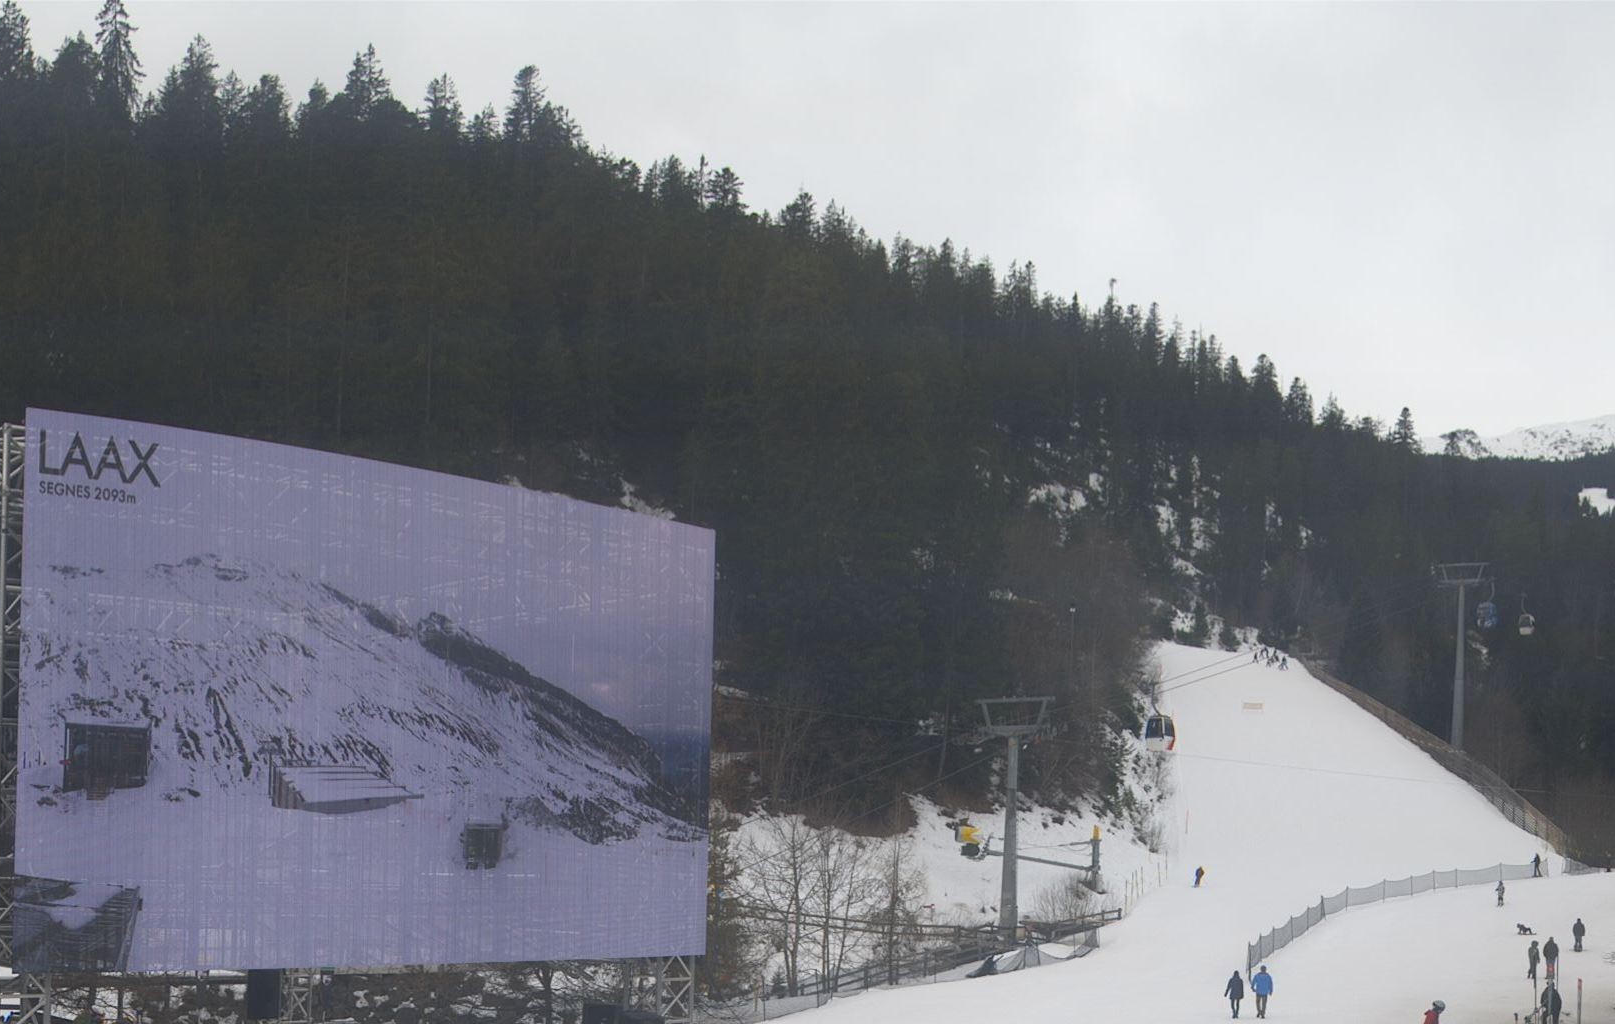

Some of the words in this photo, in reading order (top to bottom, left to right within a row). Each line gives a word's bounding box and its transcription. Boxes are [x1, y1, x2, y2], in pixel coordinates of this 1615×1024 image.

[39, 429, 161, 488] LAAX
[39, 481, 91, 499] SEGNES
[94, 487, 136, 504] 2093m
